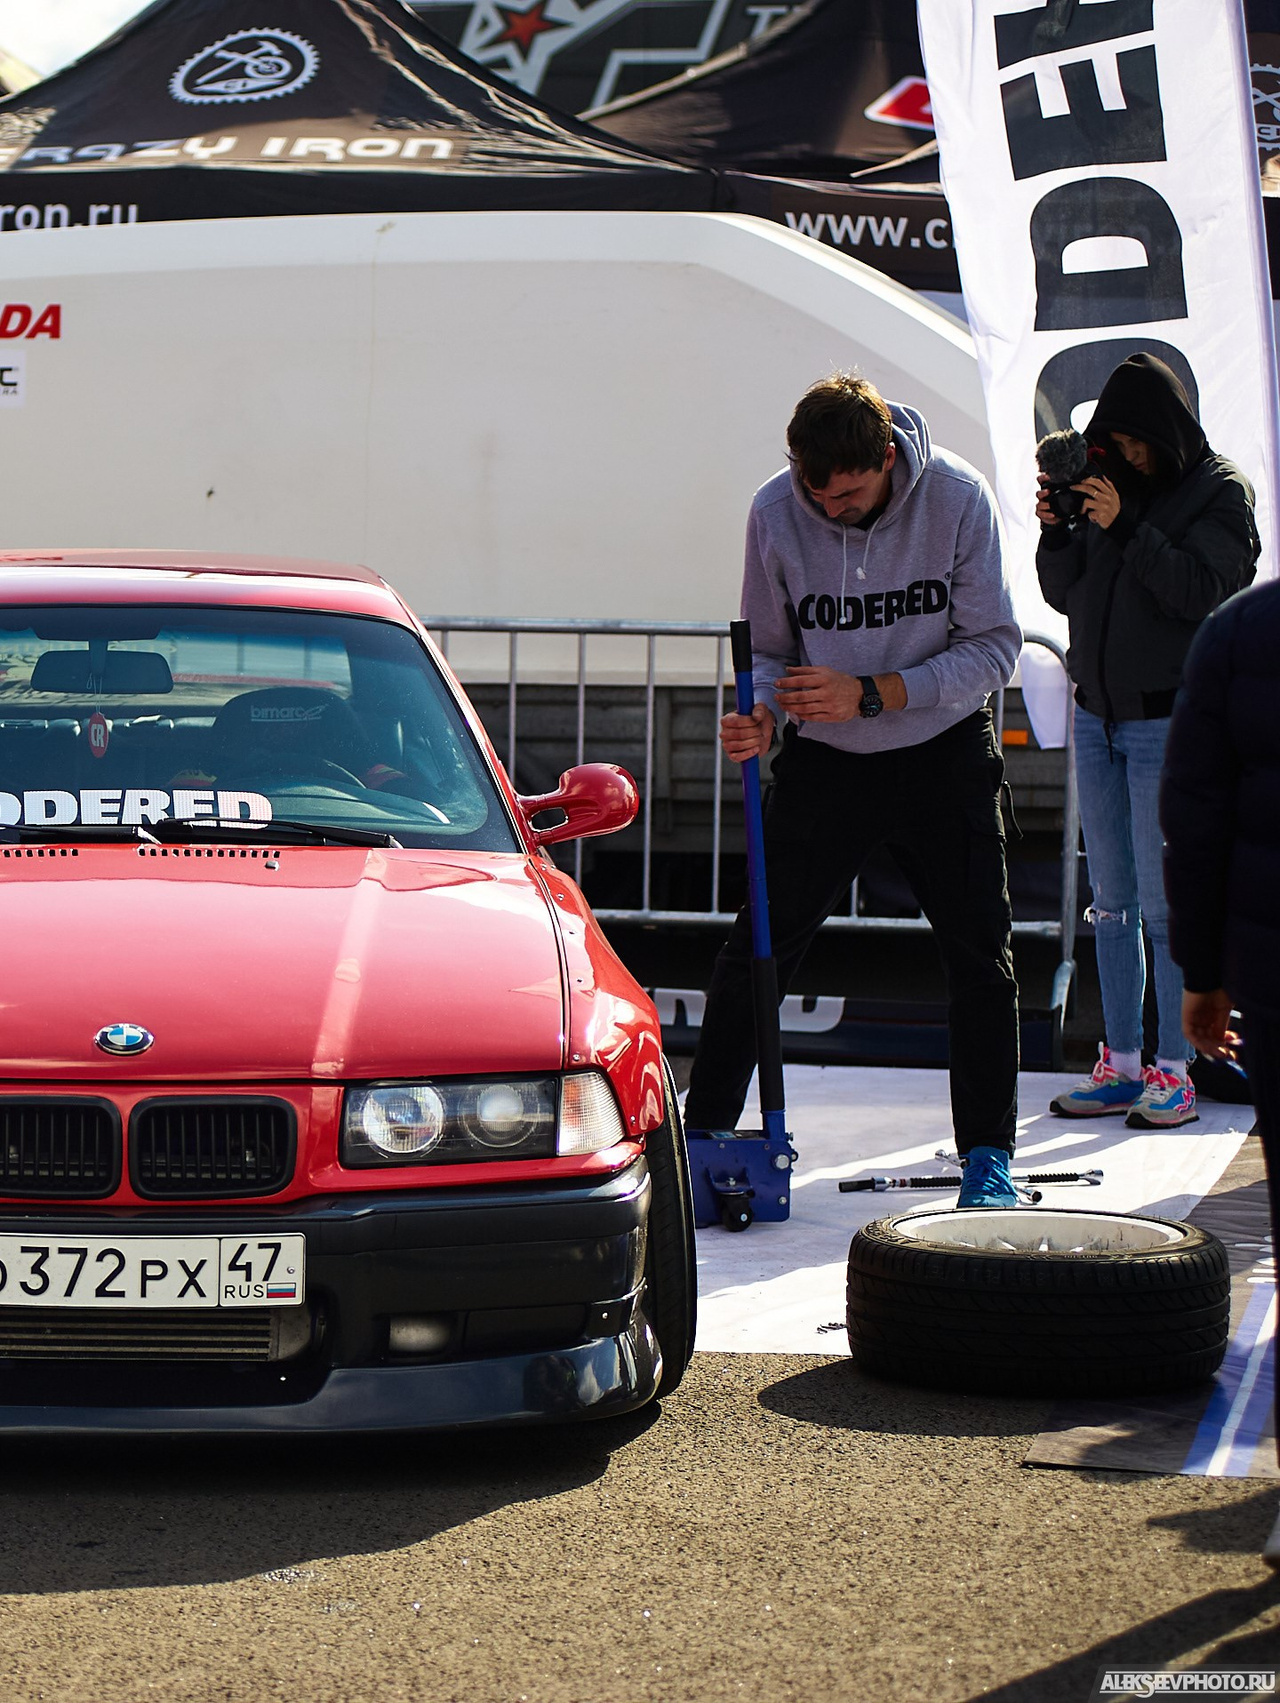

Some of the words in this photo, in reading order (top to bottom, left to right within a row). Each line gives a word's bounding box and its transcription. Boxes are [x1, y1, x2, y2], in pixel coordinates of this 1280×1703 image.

[260, 135, 454, 161] IRON
[797, 579, 949, 631] CODERED
[91, 724, 105, 748] CR
[228, 1243, 282, 1282] 47
[224, 1284, 264, 1299] RUS
